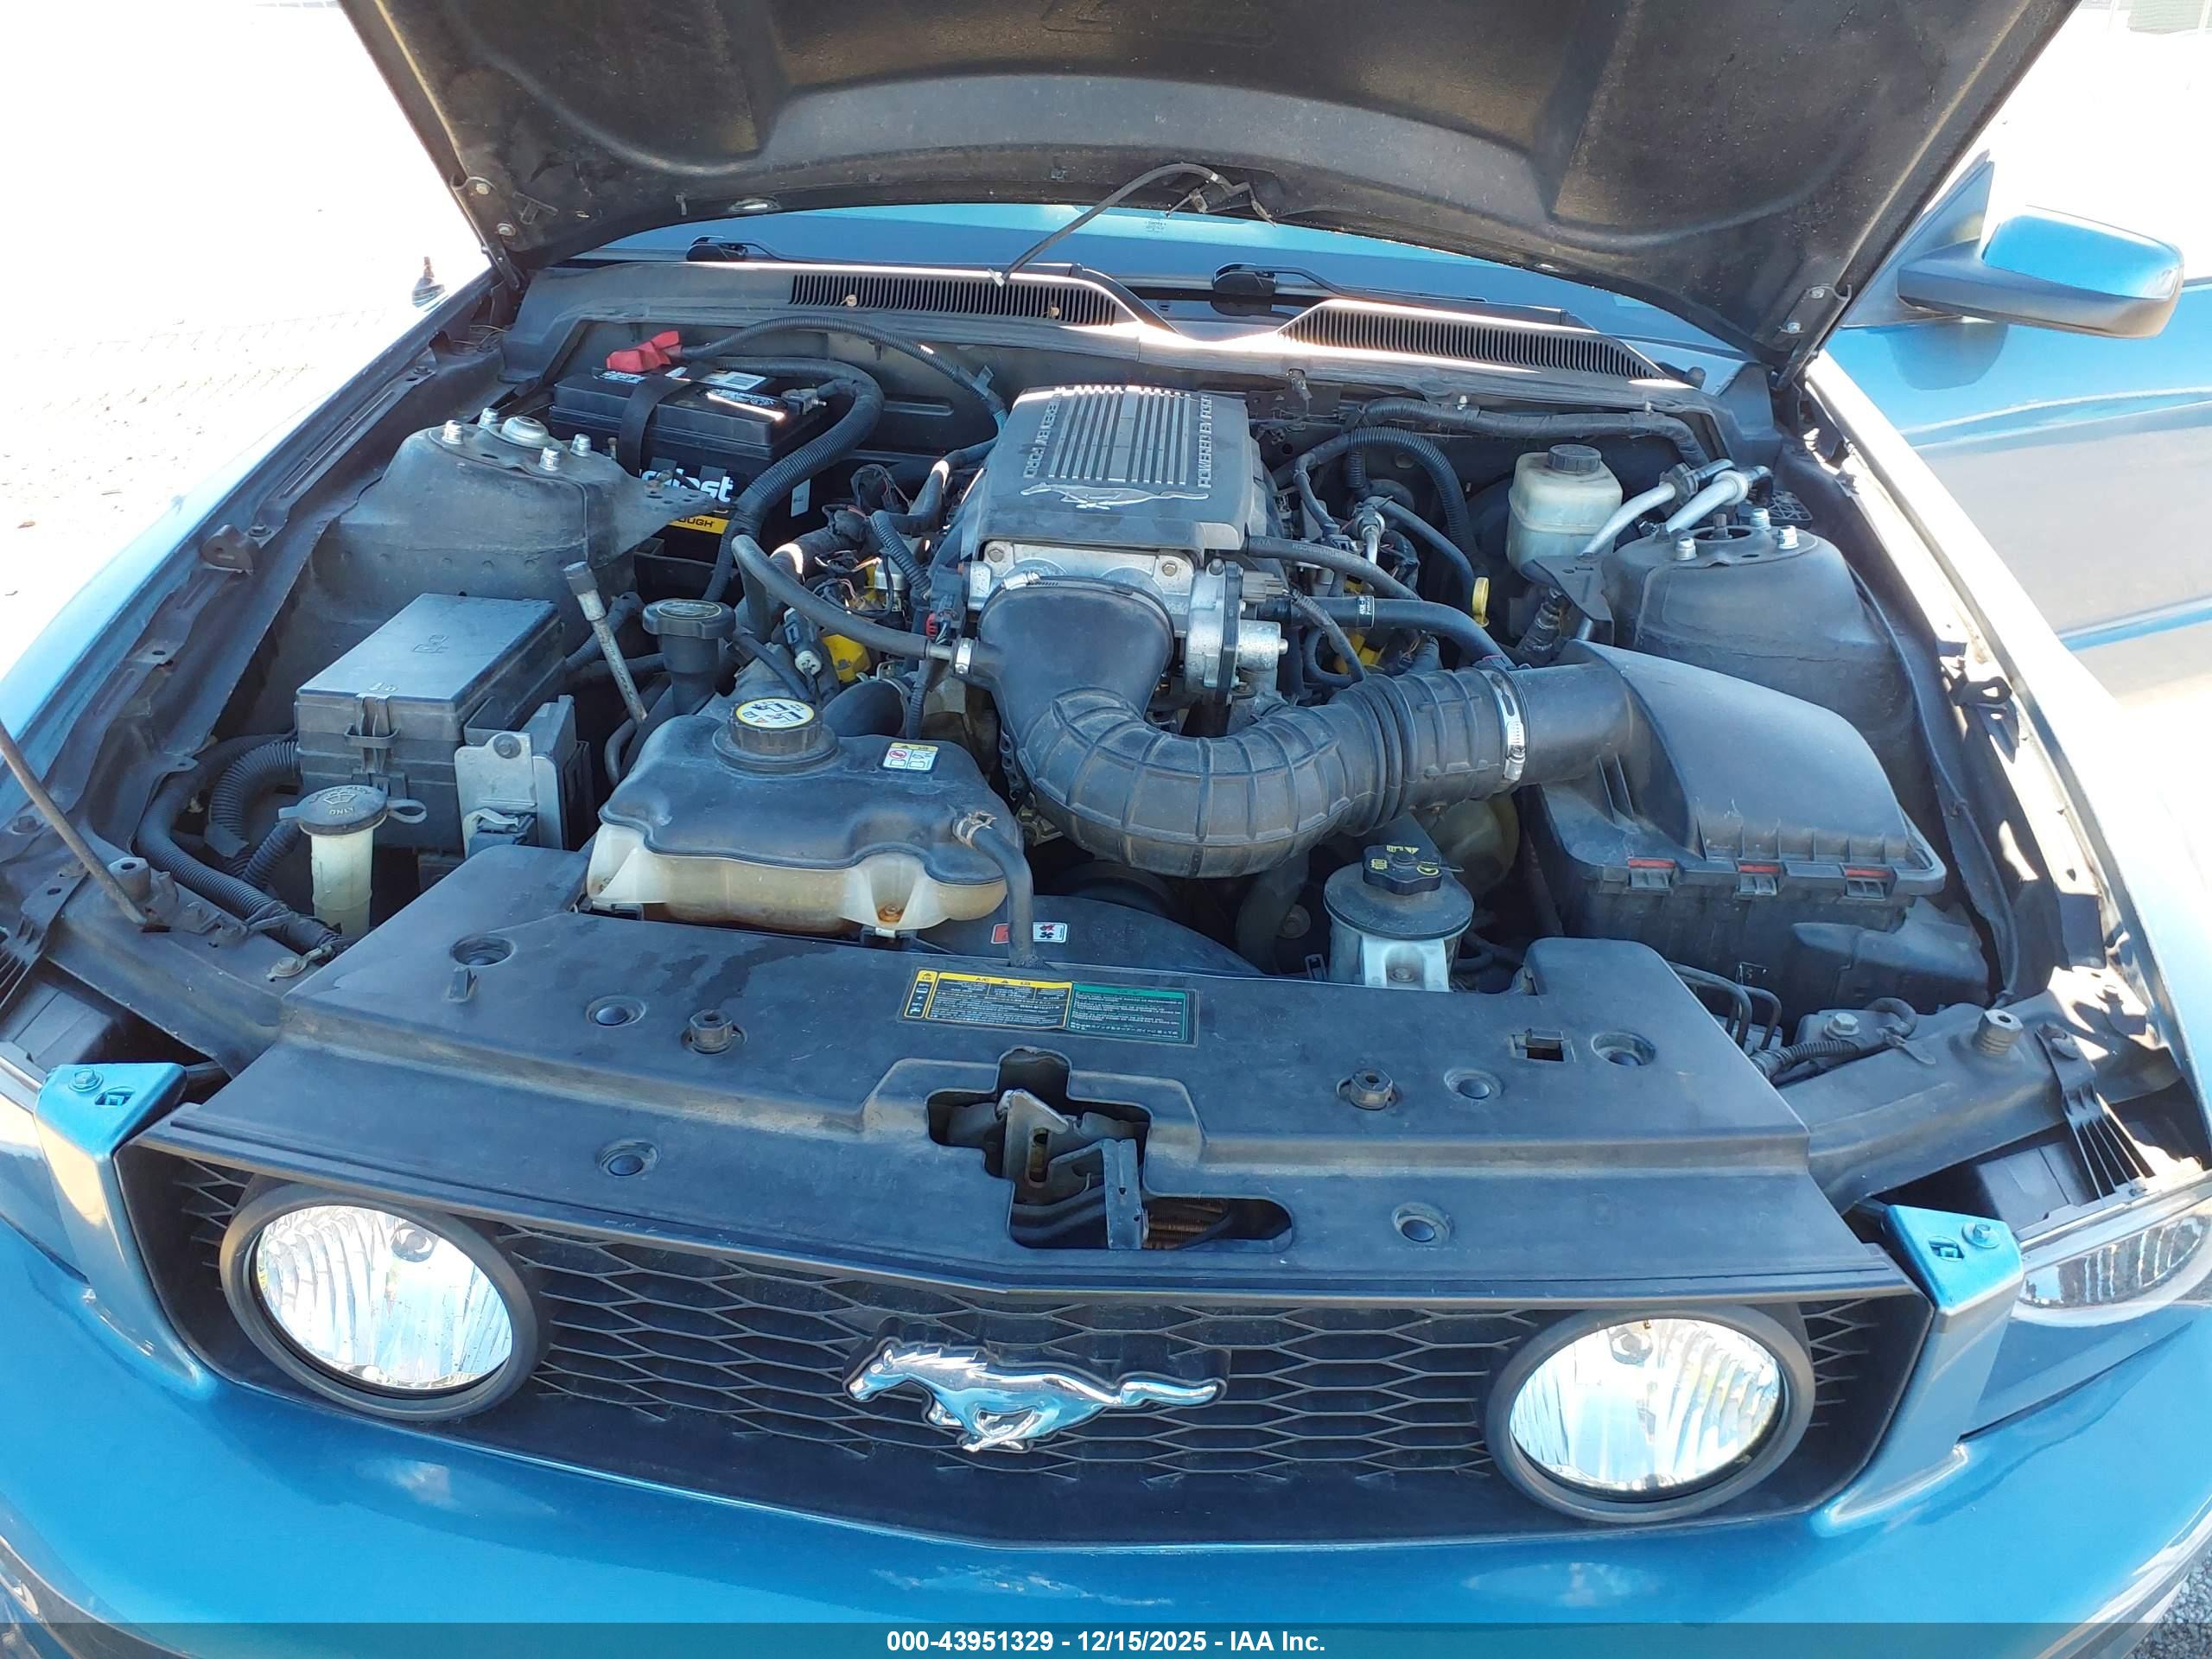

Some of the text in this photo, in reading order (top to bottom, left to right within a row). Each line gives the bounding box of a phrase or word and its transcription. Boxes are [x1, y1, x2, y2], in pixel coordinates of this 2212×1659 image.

[1035, 430, 1052, 446] BY
[1023, 447, 1046, 478] FORD
[1198, 435, 1212, 488] POWERED
[330, 807, 354, 816] ONLY
